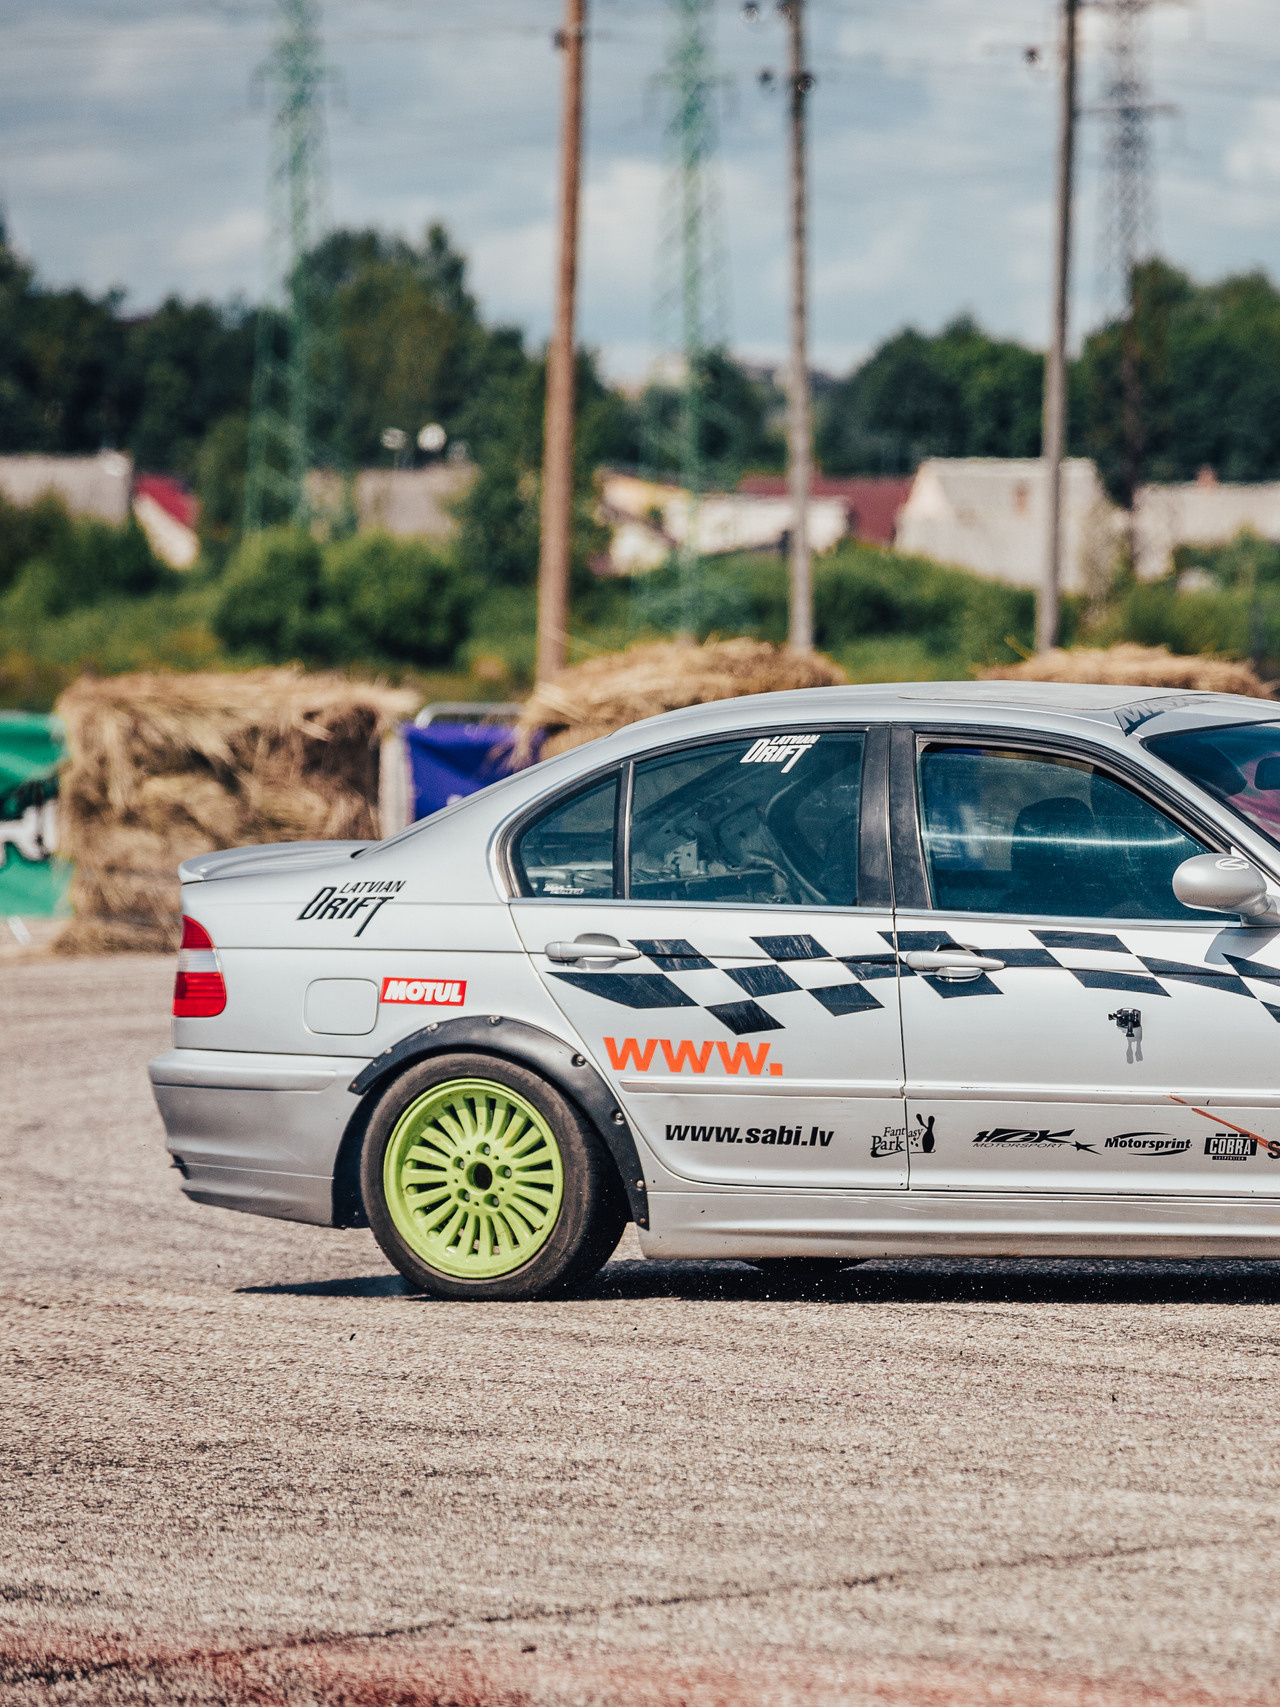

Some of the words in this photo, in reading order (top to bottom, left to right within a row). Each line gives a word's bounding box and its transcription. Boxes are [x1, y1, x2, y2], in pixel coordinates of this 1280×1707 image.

[770, 735, 820, 745] LATVIAN
[740, 738, 813, 773] DRIFT
[340, 880, 406, 893] LATVIAN
[296, 886, 394, 937] DRIFT
[384, 980, 463, 1002] MOTUL
[602, 1036, 784, 1076] www.
[665, 1125, 835, 1147] www.sabi.lv
[883, 1126, 924, 1140] Fantasy
[870, 1135, 906, 1152] Park
[1104, 1137, 1191, 1150] Motorsprint
[1209, 1138, 1251, 1155] COBRA
